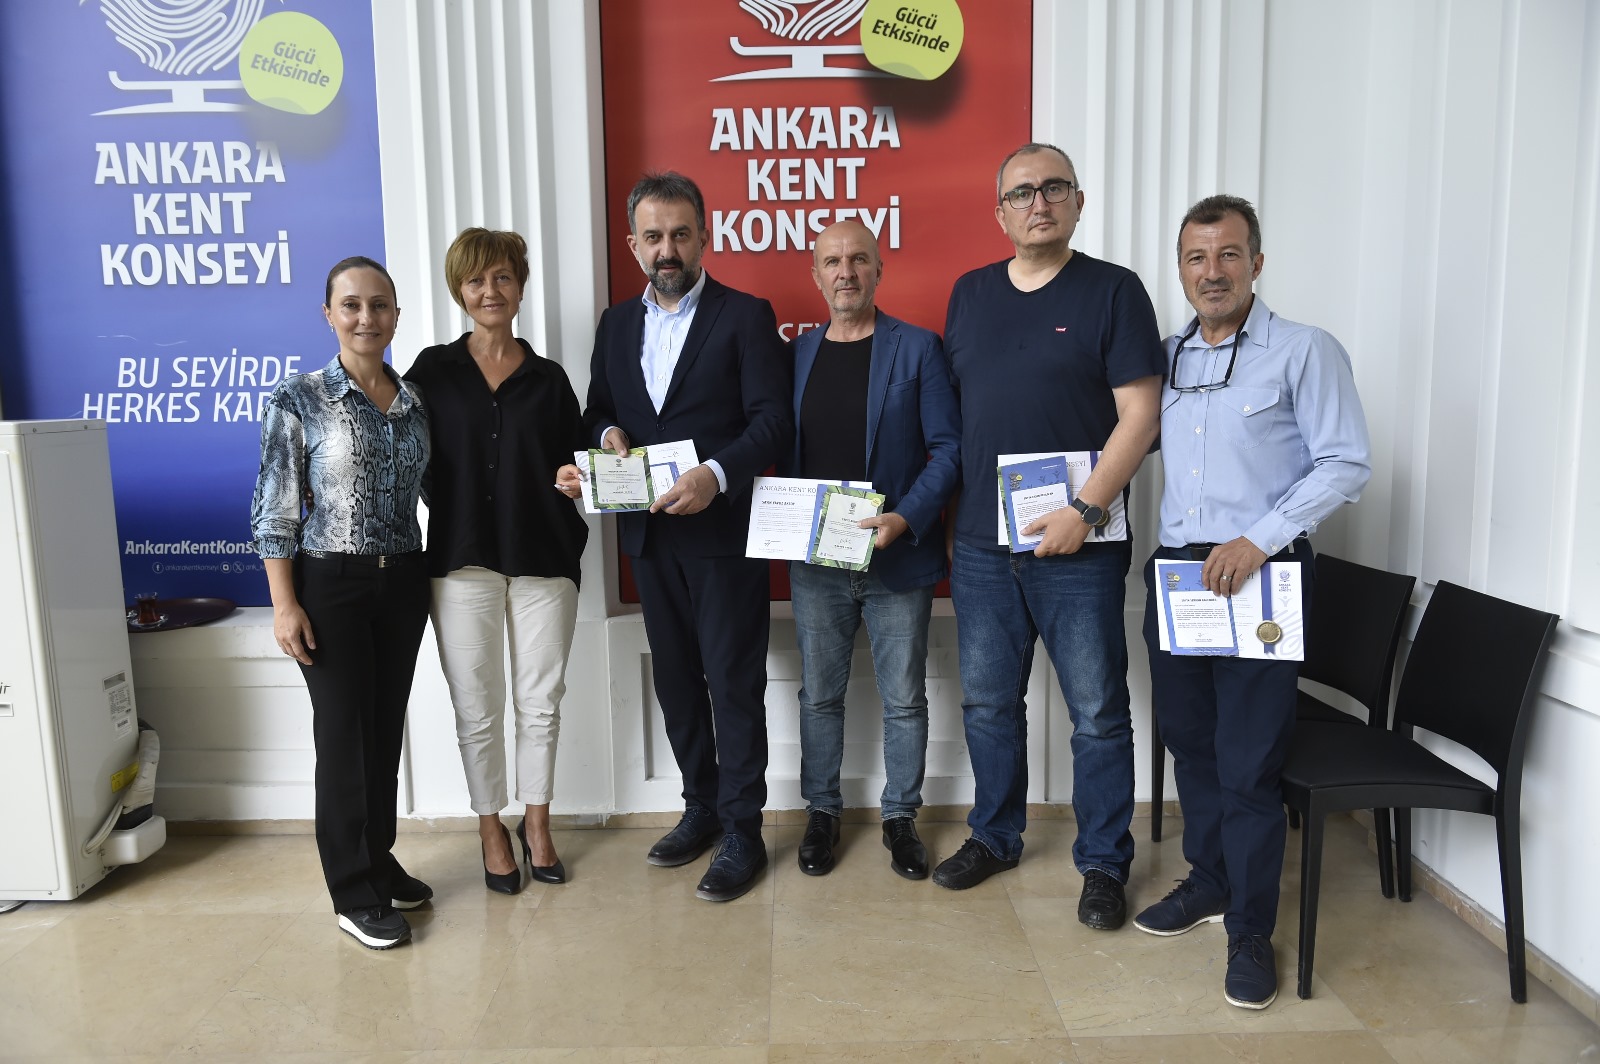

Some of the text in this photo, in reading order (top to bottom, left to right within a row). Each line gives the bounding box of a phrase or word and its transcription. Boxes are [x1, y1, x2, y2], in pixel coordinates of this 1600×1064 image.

[872, 19, 949, 53] Etkisinde
[895, 7, 937, 31] Gücü
[250, 54, 330, 88] Etkisinde
[273, 41, 316, 65] Gücü
[709, 106, 900, 151] ANKARA
[94, 141, 286, 184] ANKARA
[748, 157, 865, 201] KENT
[133, 192, 251, 235] KENT
[712, 195, 900, 252] KONSYİ
[100, 230, 291, 285] KONSEYİ
[117, 348, 301, 388] BU SEYİRDE
[83, 392, 200, 423] HERKES
